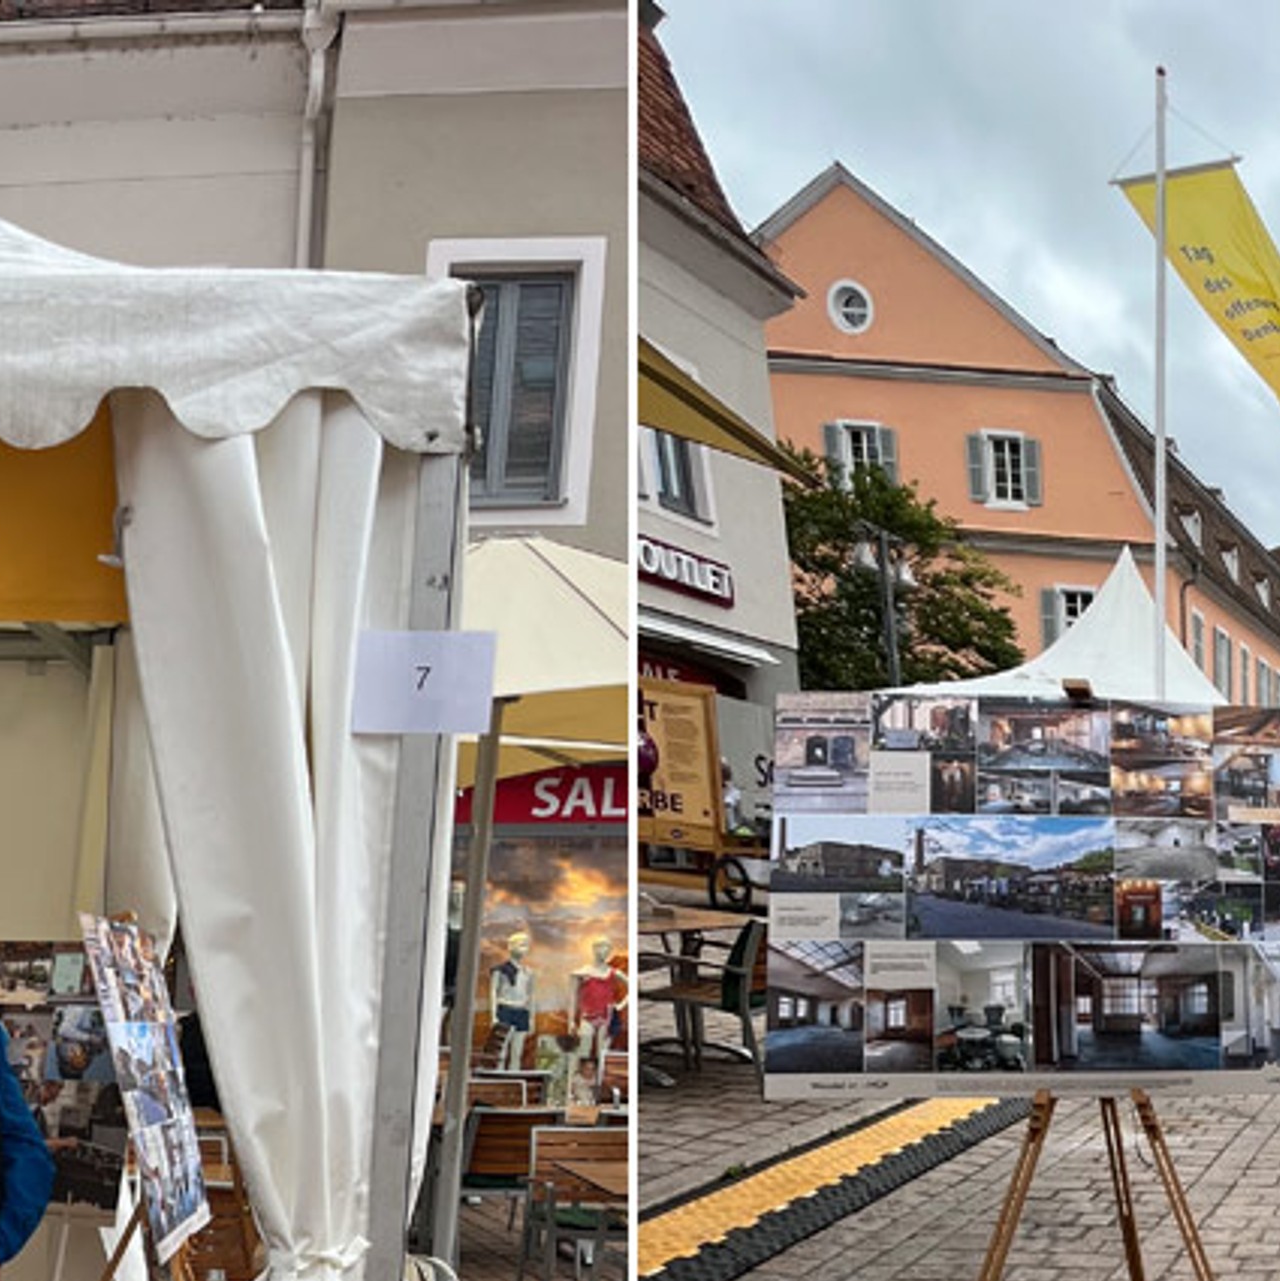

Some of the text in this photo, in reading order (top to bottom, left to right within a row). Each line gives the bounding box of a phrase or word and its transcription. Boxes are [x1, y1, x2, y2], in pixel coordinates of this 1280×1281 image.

[1179, 245, 1215, 265] Tag
[1203, 275, 1233, 294] des
[638, 539, 732, 600] OUTLET
[415, 665, 431, 692] 7
[531, 777, 626, 818] SAL
